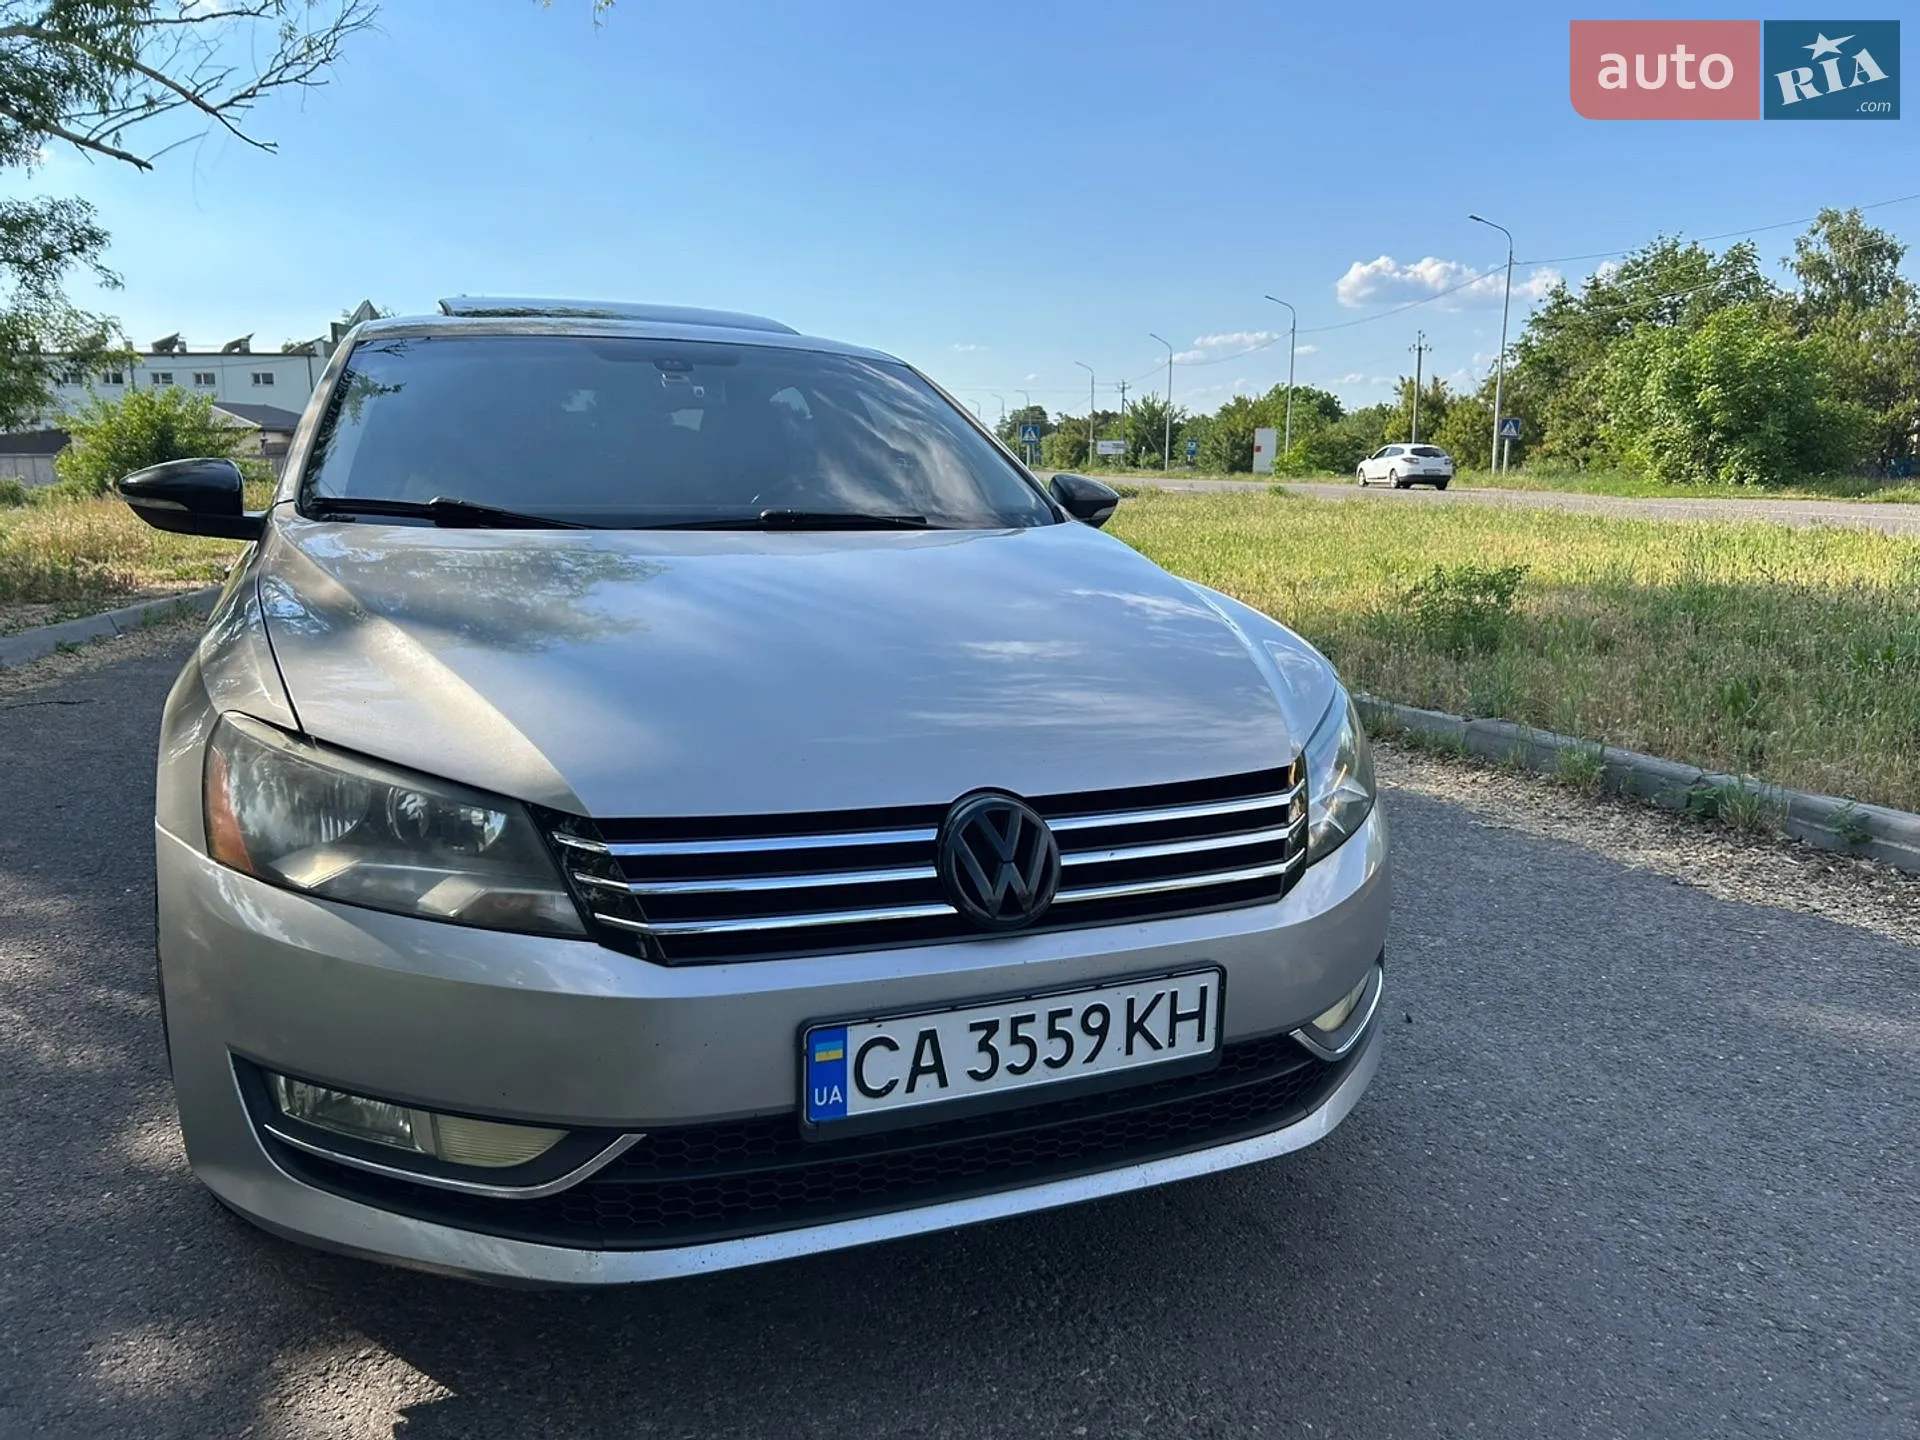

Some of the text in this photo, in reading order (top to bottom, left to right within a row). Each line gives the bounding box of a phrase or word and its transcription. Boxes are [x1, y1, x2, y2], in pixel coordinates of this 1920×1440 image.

[853, 984, 1209, 1099] CA 3559 KH
[814, 1084, 843, 1107] UA
